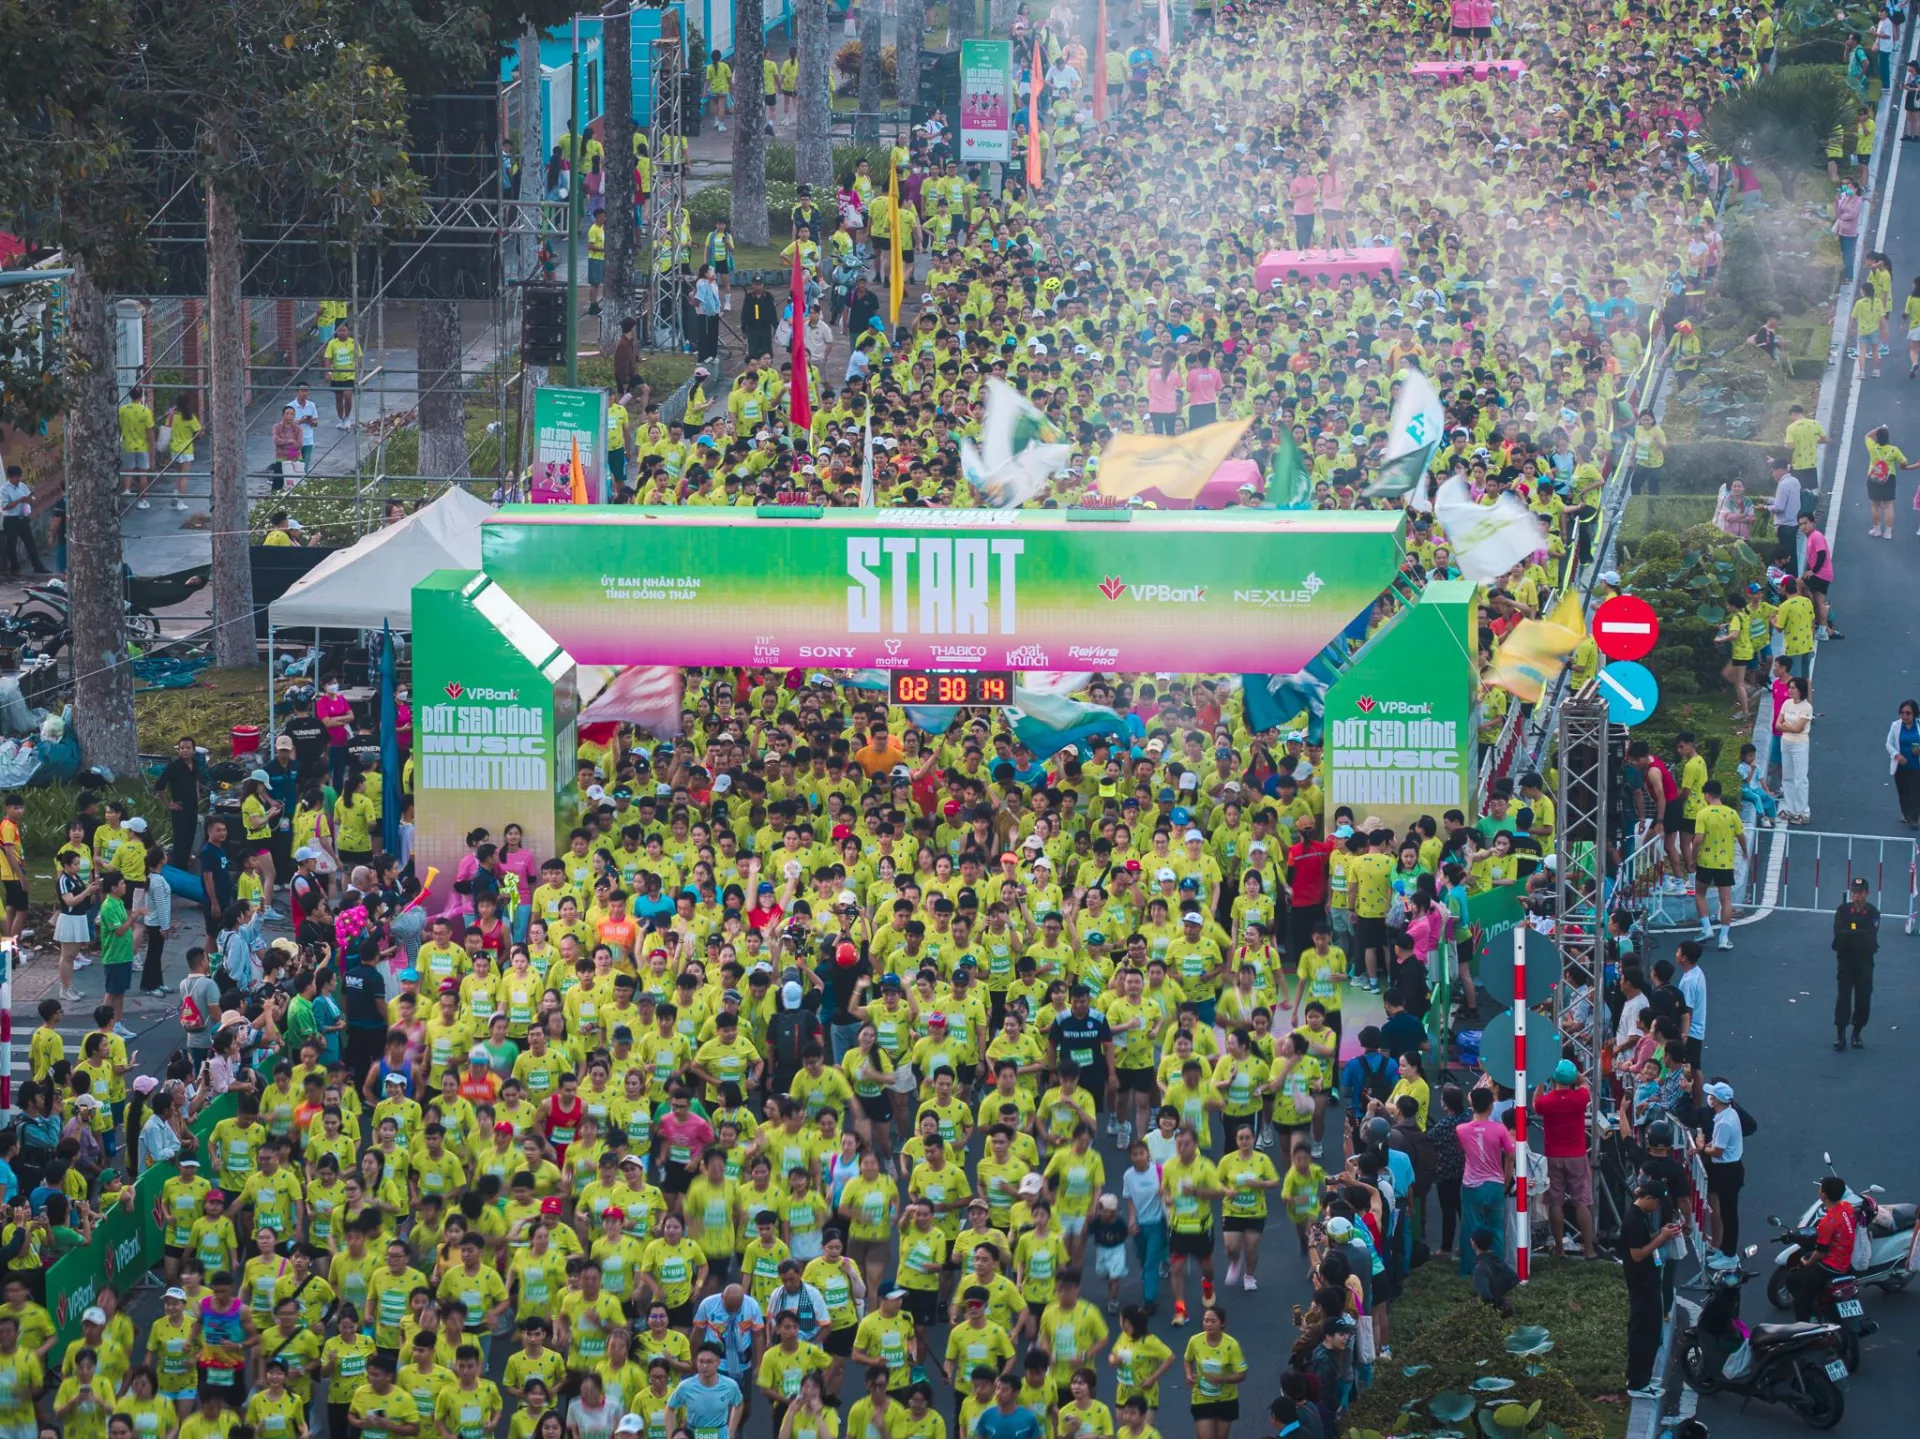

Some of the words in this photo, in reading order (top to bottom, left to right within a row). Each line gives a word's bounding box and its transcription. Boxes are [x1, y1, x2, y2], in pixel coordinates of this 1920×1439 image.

[977, 140, 1003, 148] VPBank
[618, 578, 640, 587] BAN
[643, 576, 675, 588] NHÂN
[677, 576, 701, 588] DÂN
[847, 537, 1024, 635] START
[605, 586, 630, 599] TỈNH
[632, 585, 666, 600] ĐỒNG
[669, 588, 697, 600] THÁP
[1130, 584, 1206, 602] VPBank
[1234, 589, 1312, 607] NEXUS
[754, 644, 780, 656] true
[799, 646, 856, 658] SONY
[929, 645, 987, 657] THABICO
[1019, 643, 1042, 657] oat
[753, 656, 779, 665] WATER
[1006, 651, 1049, 667] krunch
[1092, 657, 1116, 666] PRO
[466, 687, 518, 701] VPBank
[898, 676, 929, 702] 02
[939, 676, 966, 702] 30
[981, 677, 1005, 702] 14
[1378, 701, 1432, 714] VPBank
[421, 703, 456, 734] ĐẤT
[458, 706, 493, 735] SEN
[495, 703, 543, 735] HỒNG
[1332, 716, 1368, 748] ĐẤT
[1369, 719, 1406, 748] SEN
[1407, 717, 1457, 749] HỒNG
[348, 745, 381, 754] RUNNER
[422, 735, 546, 755] MUSIC
[1332, 749, 1460, 769] MUSIC
[422, 755, 547, 791] MARATHON
[1332, 769, 1460, 805] MARATHON
[114, 1229, 141, 1274] VPBank
[67, 1275, 96, 1321] VPBank
